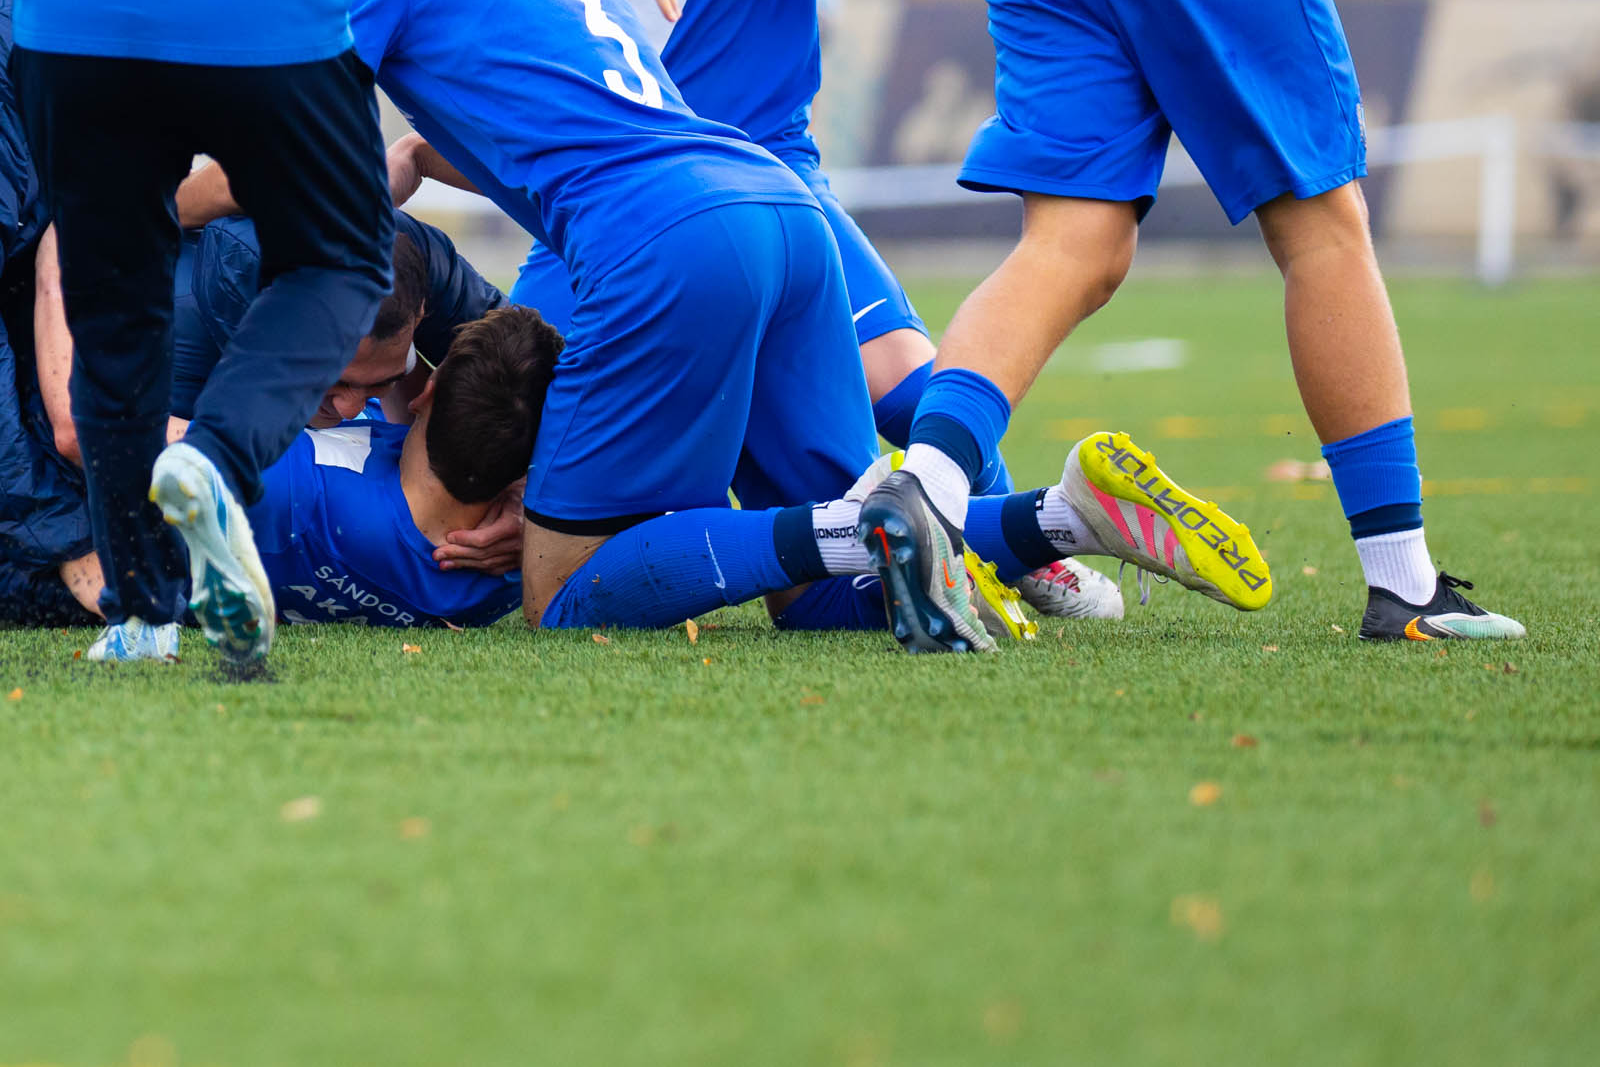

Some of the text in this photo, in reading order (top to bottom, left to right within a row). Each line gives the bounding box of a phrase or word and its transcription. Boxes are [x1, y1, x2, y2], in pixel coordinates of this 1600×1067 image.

[813, 524, 861, 540] IONSOCK
[1095, 435, 1268, 592] PREDATOR
[314, 565, 415, 627] SÁNDOR
